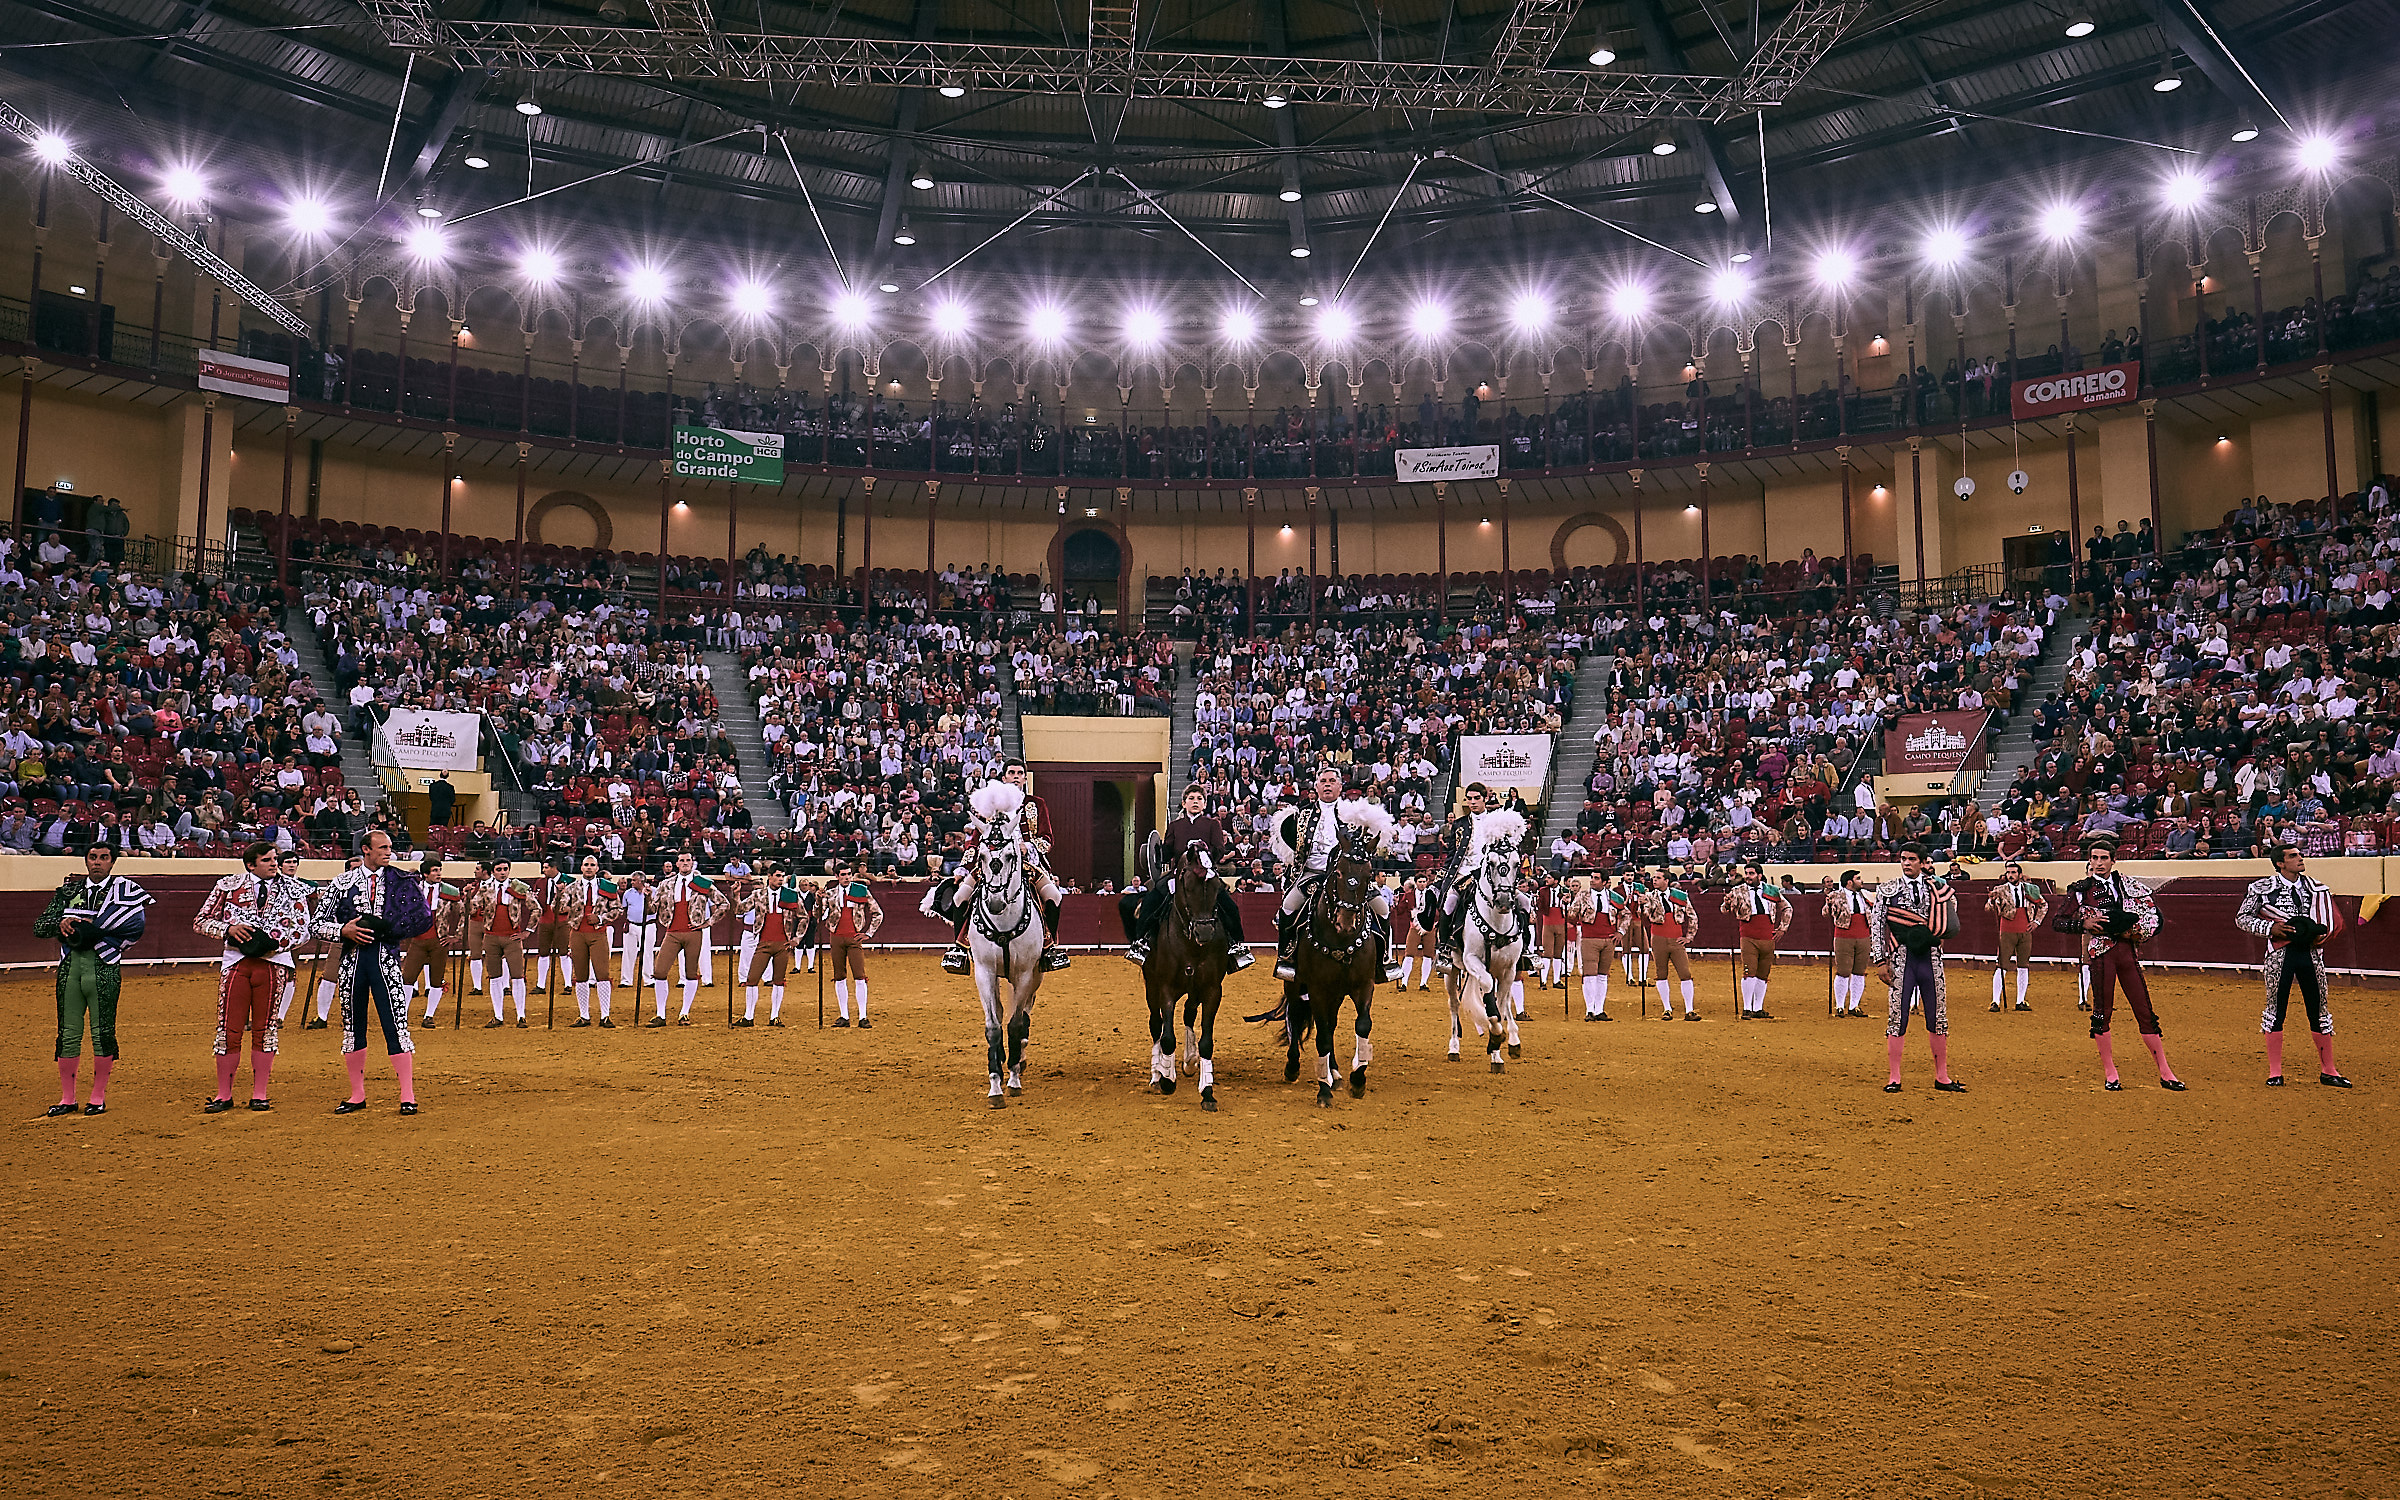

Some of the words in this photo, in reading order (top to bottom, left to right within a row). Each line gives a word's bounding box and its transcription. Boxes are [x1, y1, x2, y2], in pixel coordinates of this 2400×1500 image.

[223, 370, 247, 380] Jornal
[247, 373, 287, 387] Económico
[2023, 369, 2126, 404] CORREIO
[676, 431, 725, 448] Horto
[676, 450, 692, 460] do
[693, 447, 754, 466] Campo
[756, 447, 778, 457] HCG
[675, 460, 738, 478] Grande
[393, 747, 420, 756] CAMPO
[422, 749, 457, 758] PEQUENO
[1905, 752, 1931, 761] CAMPO
[1933, 751, 1968, 760] PEQUENO
[1477, 769, 1502, 777] CAMPO
[1503, 769, 1534, 777] PEQUENO
